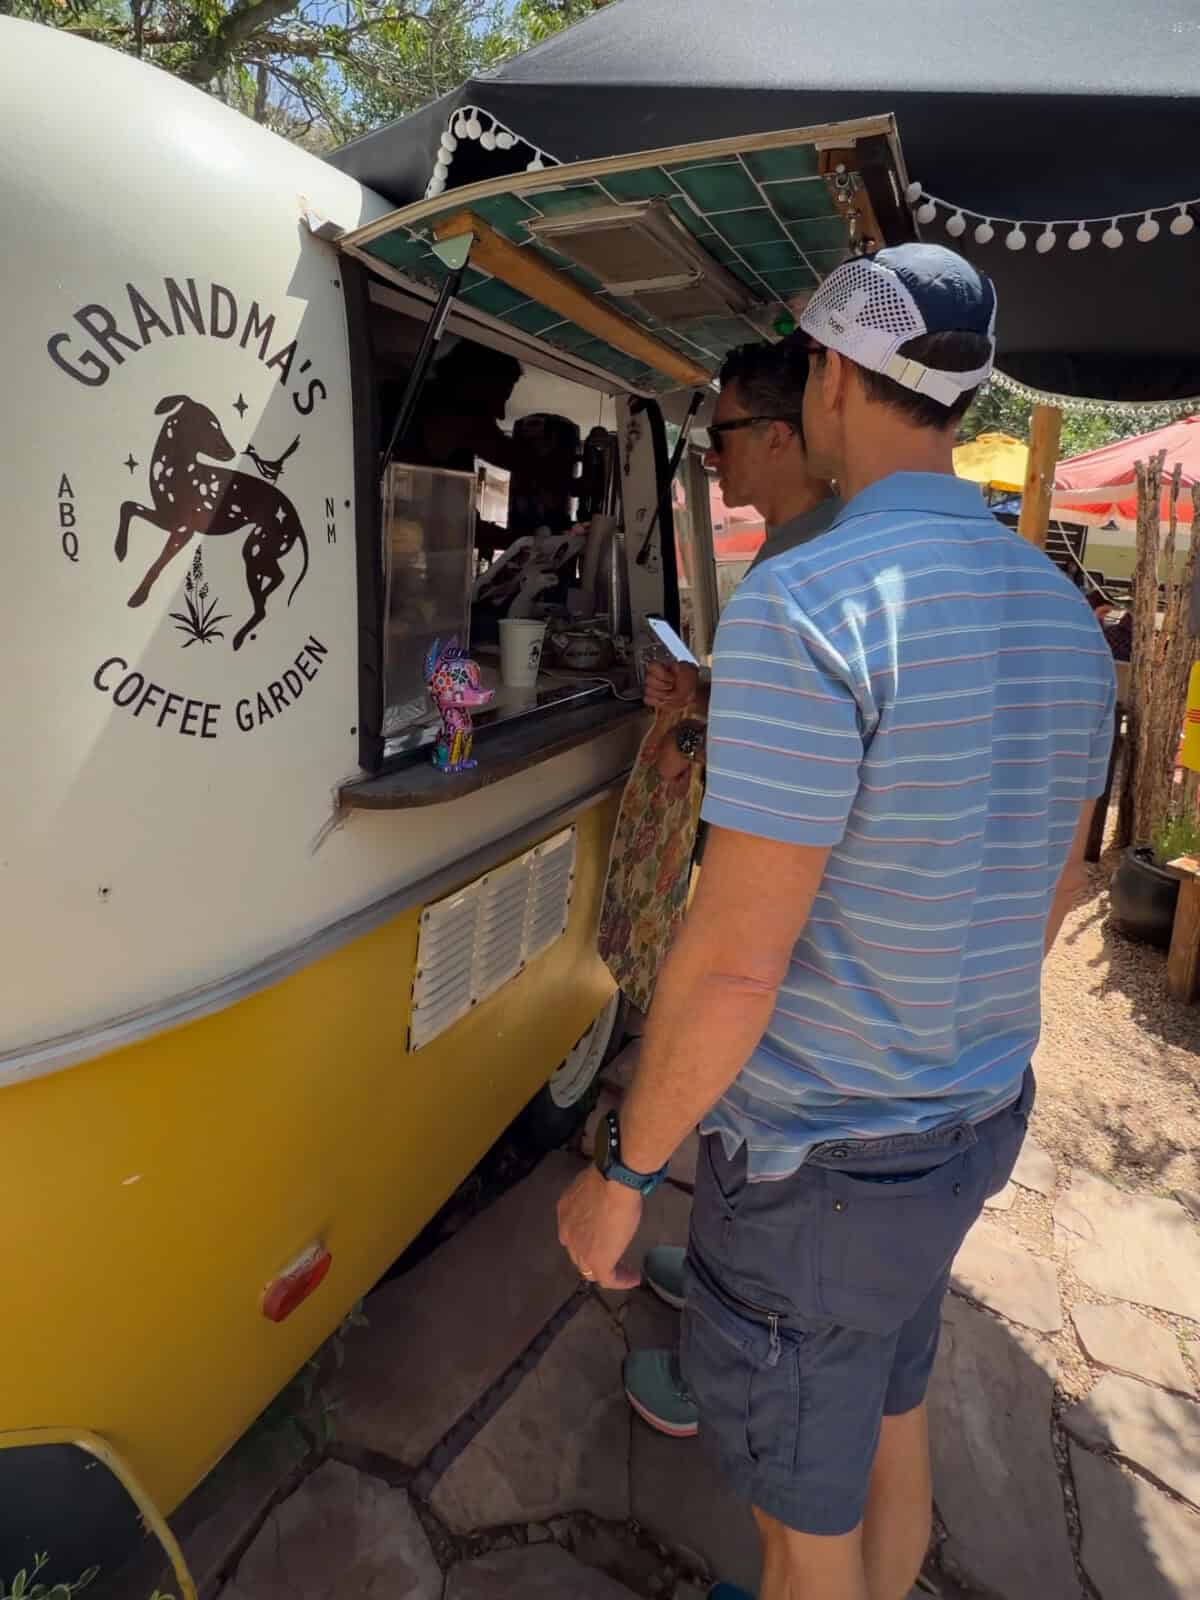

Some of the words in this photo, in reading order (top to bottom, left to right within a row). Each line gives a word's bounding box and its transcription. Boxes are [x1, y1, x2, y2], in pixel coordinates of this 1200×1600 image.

[47, 277, 327, 416] GRANDMA'S
[57, 473, 80, 562] ABQ
[325, 497, 336, 544] NM
[93, 656, 221, 738] COFFEE
[236, 635, 328, 732] GARDEN
